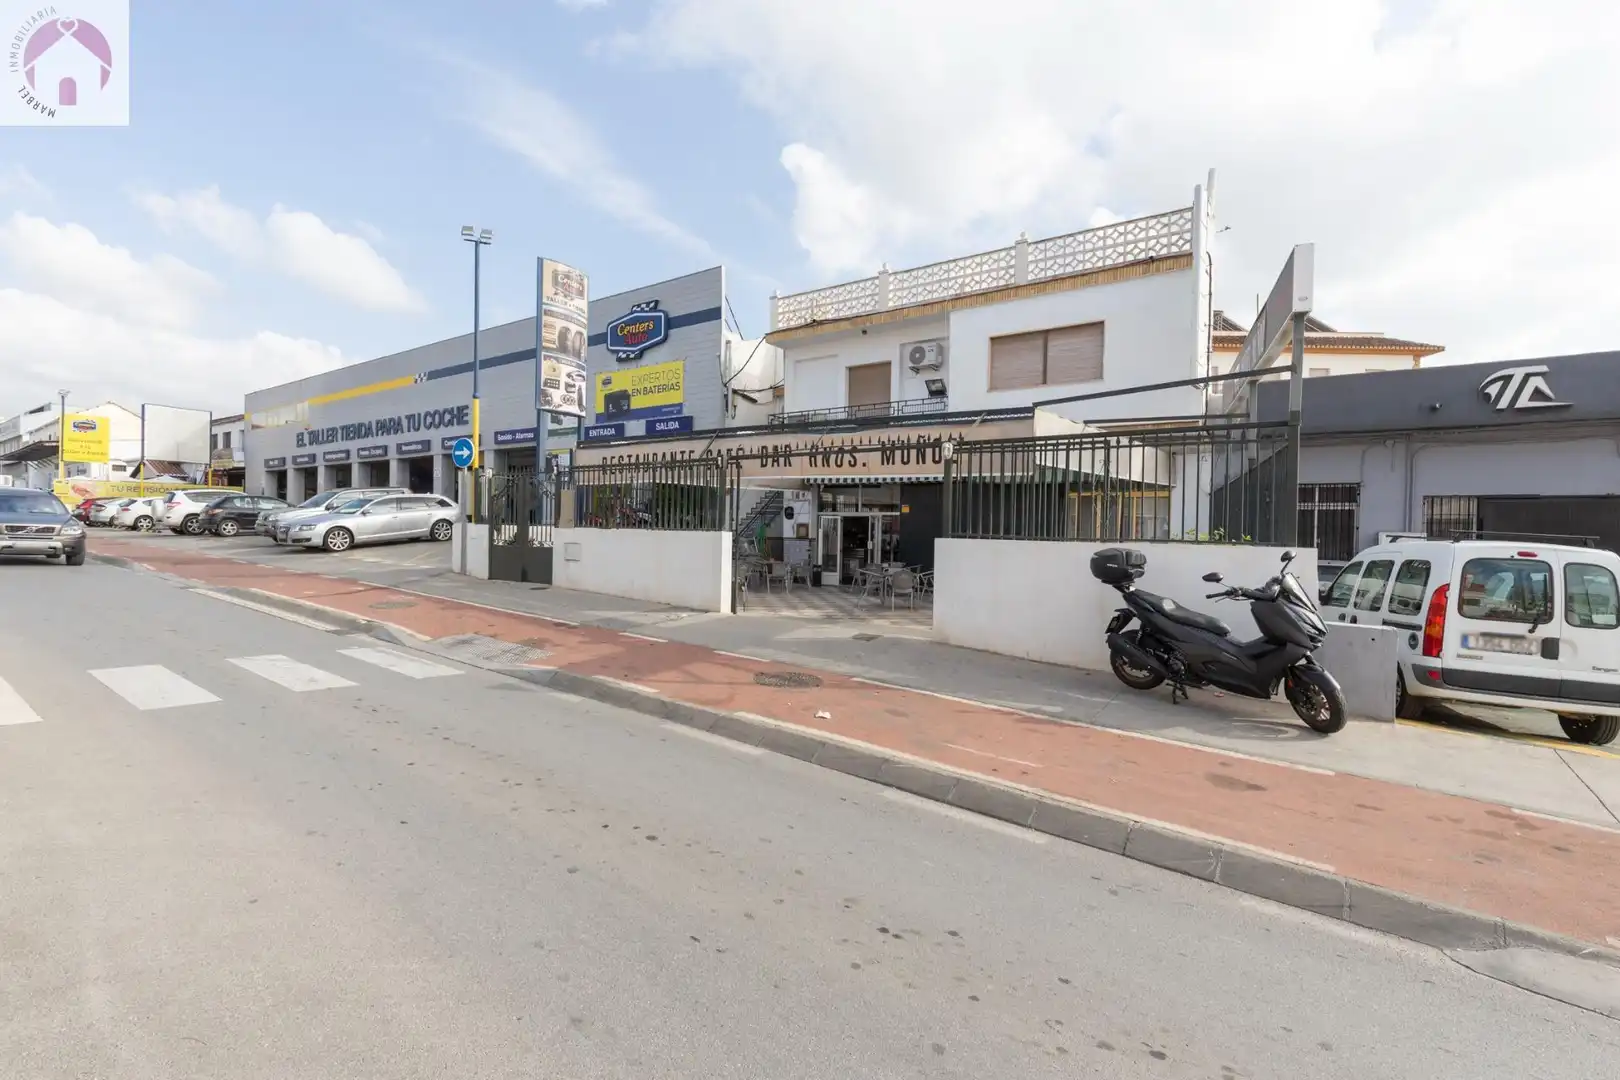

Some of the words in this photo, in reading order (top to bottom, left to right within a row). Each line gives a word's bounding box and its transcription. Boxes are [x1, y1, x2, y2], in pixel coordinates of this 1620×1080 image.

[617, 319, 654, 336] Centers
[624, 334, 648, 345] Auto
[631, 368, 681, 387] EXPERTOS
[631, 388, 642, 397] EN
[643, 381, 681, 396] BATERÍAS
[296, 432, 307, 448] EL
[307, 426, 339, 446] TALLER
[339, 420, 374, 442] TIENDA
[375, 416, 405, 437] PARA
[405, 413, 422, 433] TU
[423, 405, 470, 430] COCHE
[589, 427, 616, 437] ENTRADA
[656, 421, 679, 431] SALIDA
[760, 444, 792, 468] BAR
[809, 445, 867, 468] HNOS.
[881, 434, 958, 466] MUÑO
